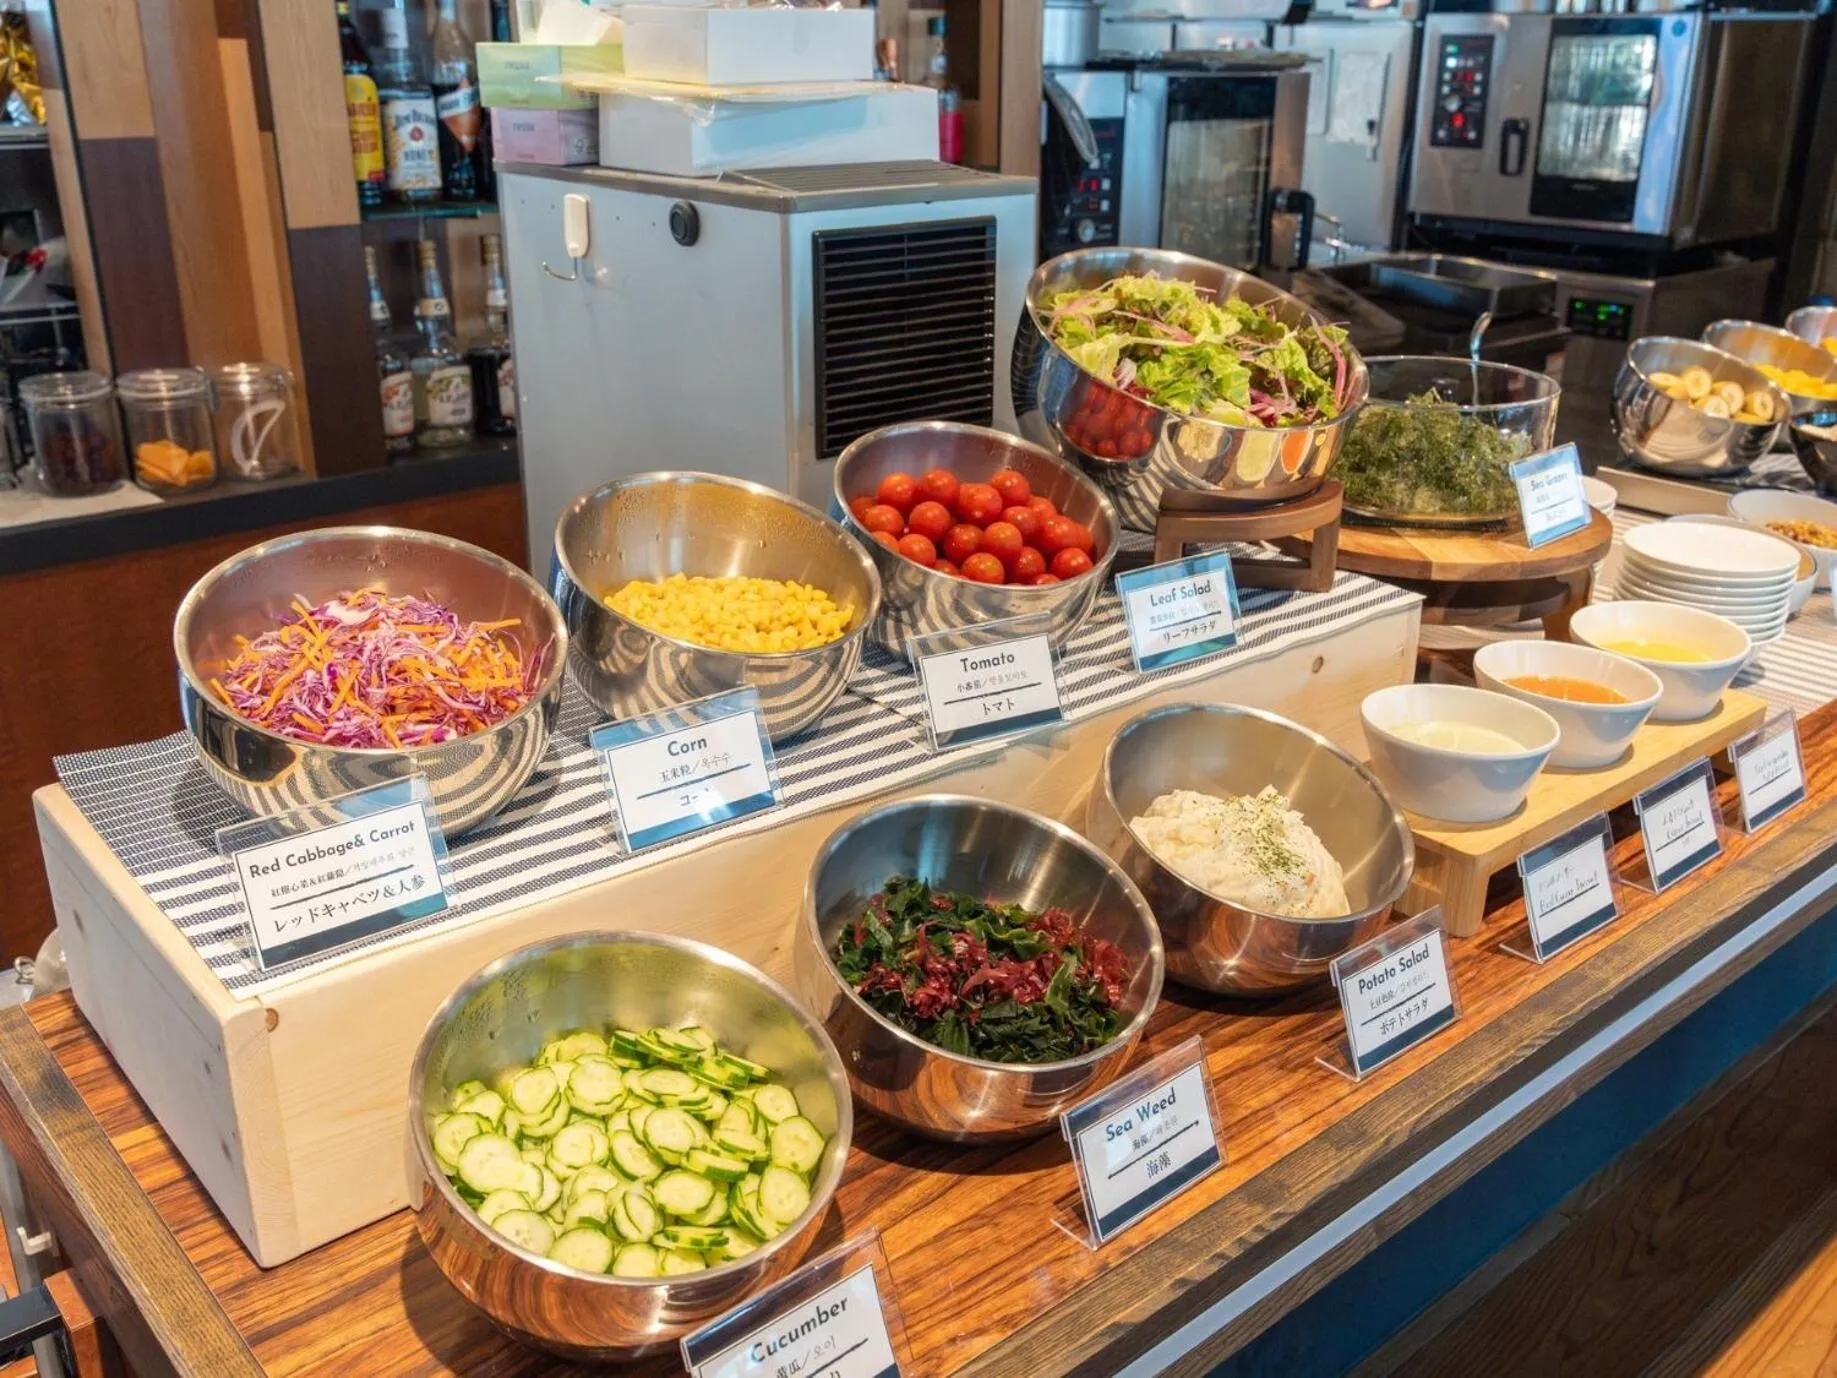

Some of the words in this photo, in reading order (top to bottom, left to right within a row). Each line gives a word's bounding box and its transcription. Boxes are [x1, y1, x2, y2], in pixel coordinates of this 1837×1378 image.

[1150, 588, 1177, 607] Leaf
[1180, 580, 1211, 600] Salad
[960, 652, 1015, 673] Tomato
[982, 697, 1015, 716] トマト
[667, 737, 708, 758] Corn
[679, 787, 711, 807] コー
[249, 862, 281, 879] Red
[285, 834, 366, 868] Cabbage&
[370, 820, 416, 842] Carrot
[1358, 967, 1397, 995] Potato
[1399, 943, 1430, 972] Salad
[1379, 997, 1429, 1036] ポテトサラダ
[1106, 1119, 1133, 1142] Sea
[1136, 1087, 1178, 1123] Weed
[750, 1296, 849, 1363] Cucumber
